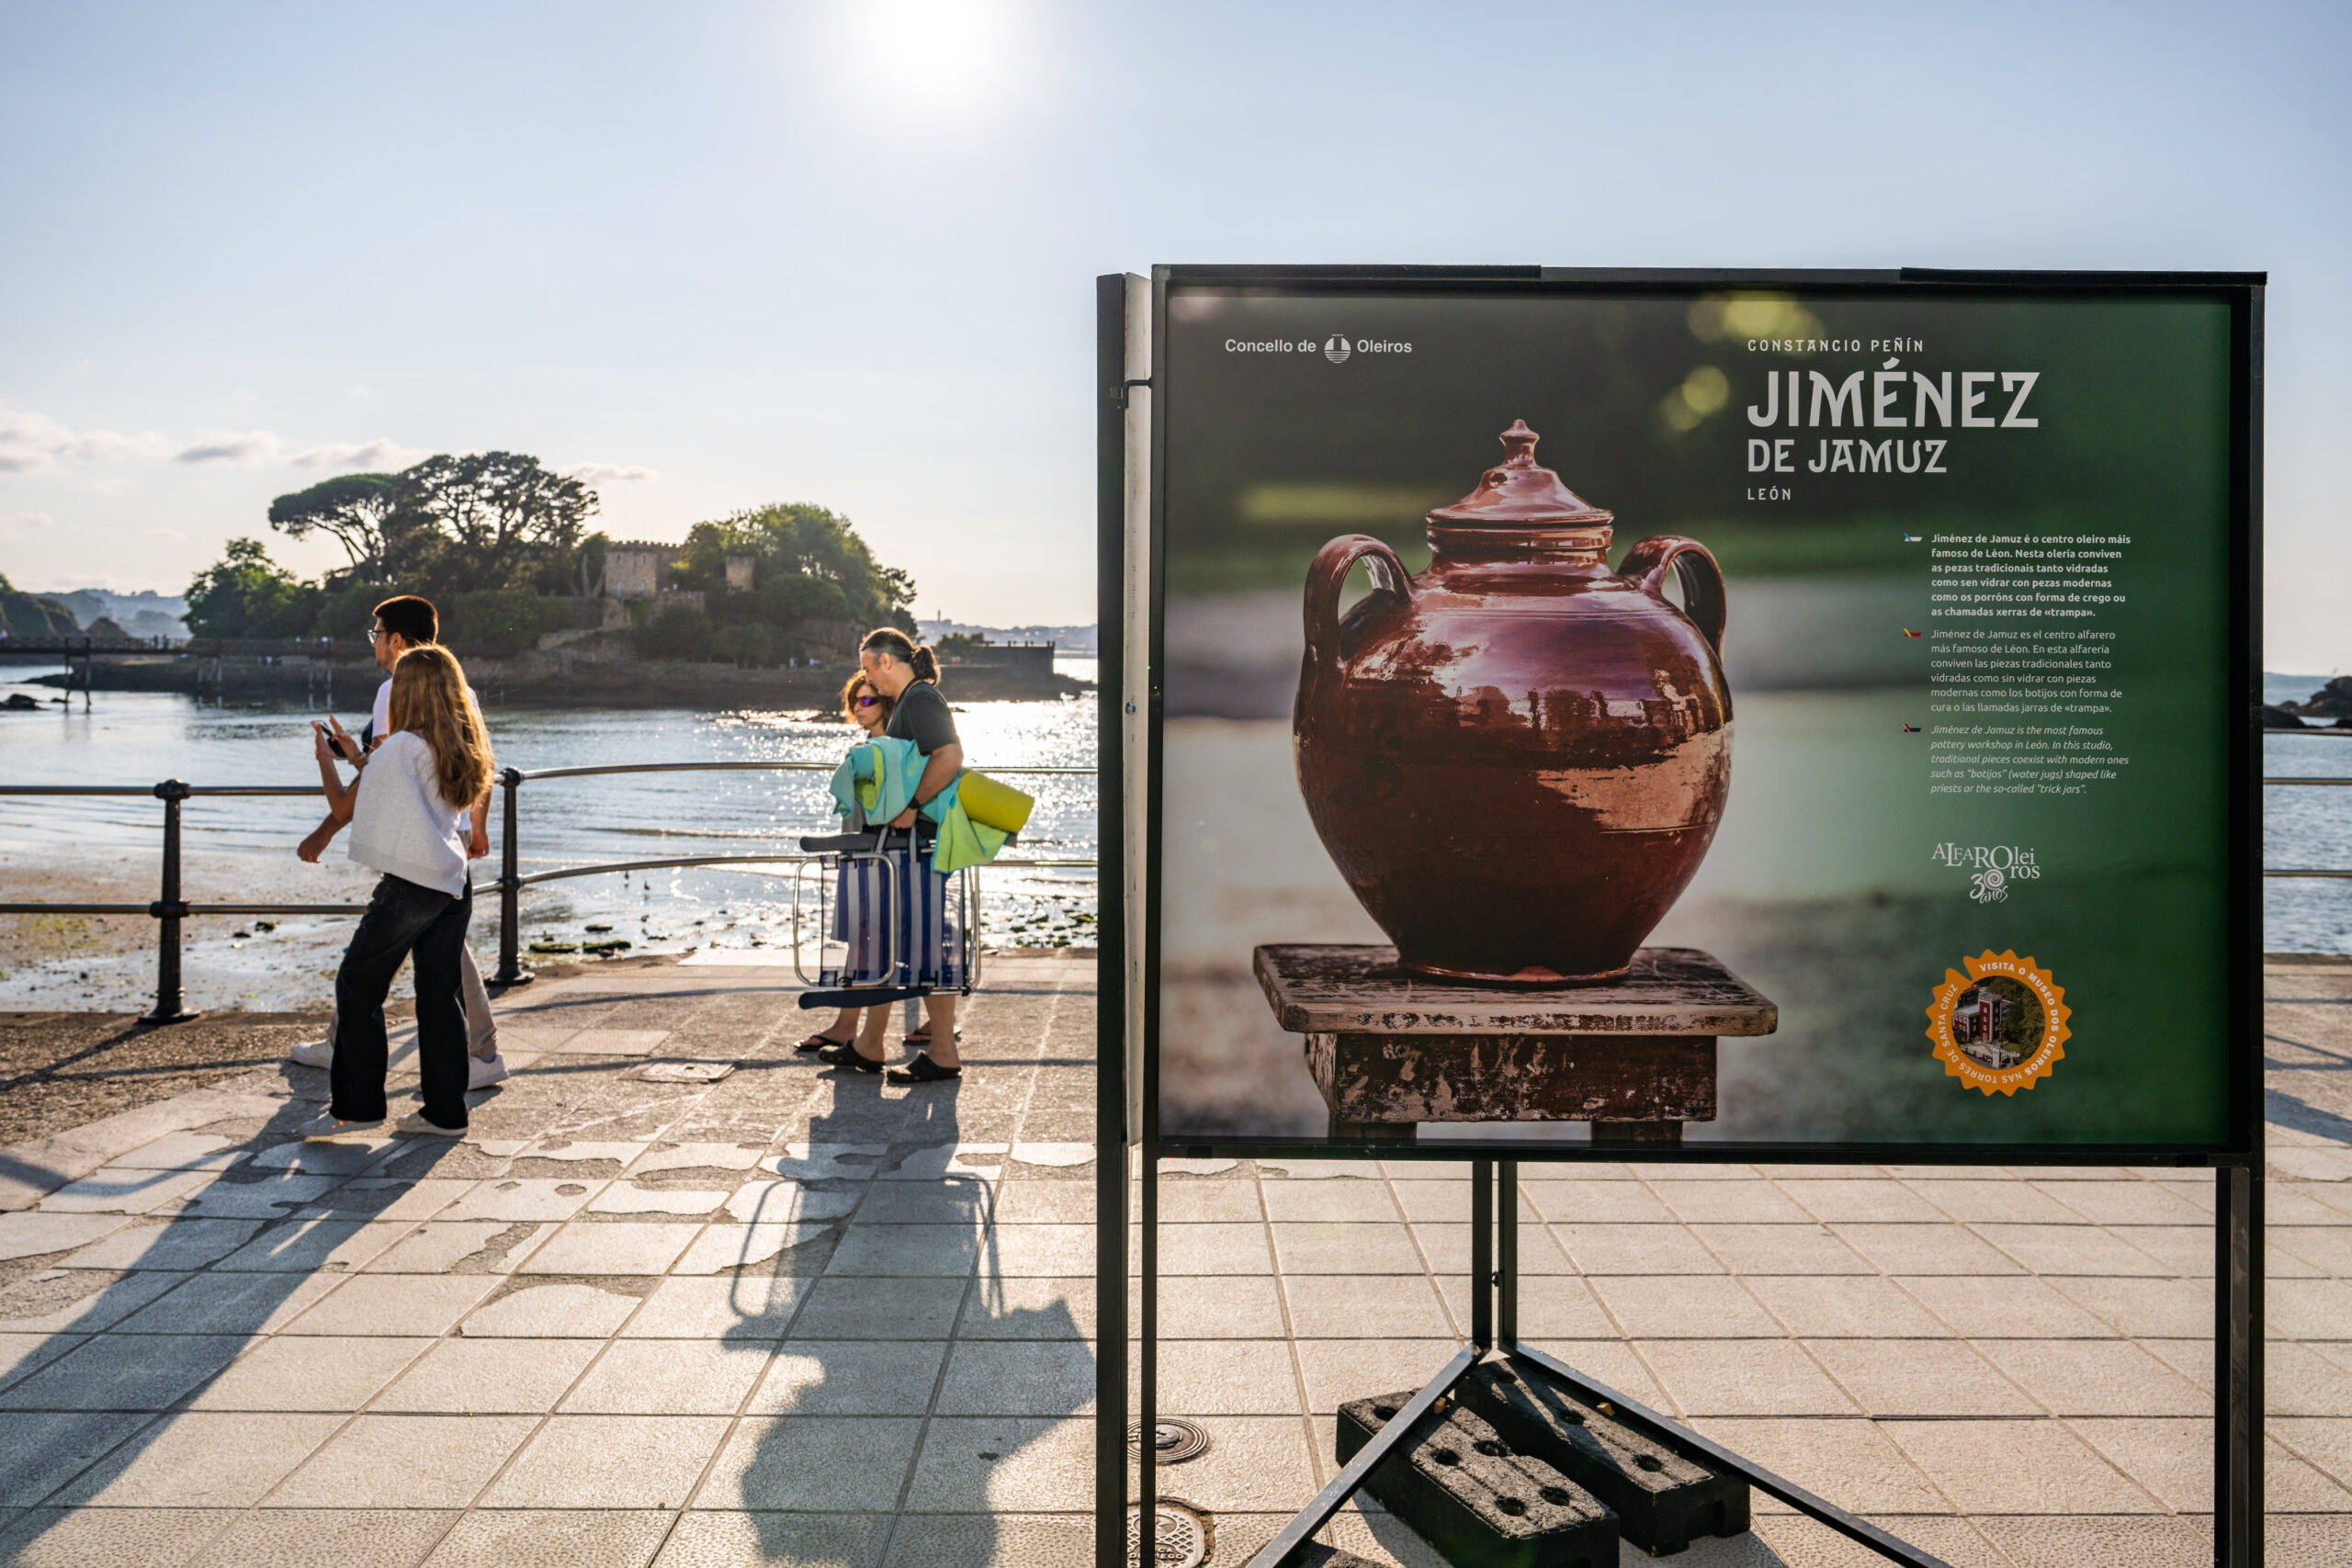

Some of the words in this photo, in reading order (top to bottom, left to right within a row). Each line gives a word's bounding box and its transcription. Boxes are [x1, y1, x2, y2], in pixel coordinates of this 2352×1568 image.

[1226, 339, 1293, 352] Concello
[1298, 340, 1316, 352] de
[1357, 340, 1412, 353] Oleiros
[1748, 340, 1860, 352] CONSTANCIO
[1871, 337, 1922, 352] PEÑÍN
[1747, 357, 2040, 427] JIMÉNEZ
[1748, 439, 1794, 472] DE
[1808, 439, 1948, 473] JAMUZ
[1747, 486, 1791, 500] LEÓN
[1931, 534, 1973, 543] Jiménez
[1975, 534, 1987, 543] de
[1990, 535, 2021, 543] Jamuz
[2024, 534, 2030, 543] é
[2041, 535, 2074, 543] centro
[2076, 534, 2106, 544] oleiro
[2109, 535, 2131, 544] máis
[1932, 548, 1968, 558] famoso
[1971, 548, 1983, 558] de
[1986, 548, 2012, 558] Léon.
[2016, 549, 2044, 558] Nesta
[2047, 549, 2075, 558] olería
[2078, 549, 2121, 558] conviven
[1945, 565, 1973, 573] pezas
[1975, 563, 2034, 572] tradicionais
[2037, 564, 2064, 572] tanto
[2066, 564, 2108, 572] vidradas
[1980, 578, 2009, 587] vidrar
[2032, 581, 2060, 589] pezas
[2063, 579, 2112, 587] modernas
[1974, 592, 2013, 603] porróns
[2036, 592, 2065, 602] forma
[2068, 592, 2080, 602] de
[2083, 595, 2110, 604] crego
[1945, 607, 1994, 615] chamadas
[2030, 607, 2042, 616] de
[1931, 629, 1971, 638] Jiménez
[1973, 629, 1984, 638] de
[1987, 630, 2018, 638] Jamuz
[2033, 629, 2041, 638] el
[2044, 630, 2075, 638] centro
[2077, 630, 2115, 639] alfarero
[1931, 644, 1951, 652] más
[1953, 644, 1988, 653] famoso
[1990, 644, 2002, 653] de
[2005, 644, 2030, 653] Léon.
[2033, 645, 2044, 653] En
[2047, 645, 2067, 653] esta
[2070, 645, 2109, 653] alfarería
[1931, 659, 1973, 668] conviven
[1975, 659, 1988, 668] las
[1991, 660, 2019, 669] piezas
[2022, 660, 2083, 668] tradicionales
[2086, 660, 2111, 669] tanto
[1931, 673, 1971, 682] vidradas
[2002, 674, 2014, 682] sin
[2018, 673, 2044, 682] vidrar
[2066, 674, 2096, 684] piezas
[1931, 688, 1978, 696] modernas
[2009, 688, 2022, 697] los
[2026, 688, 2057, 699] botijos
[2080, 688, 2108, 697] forma
[2110, 689, 2122, 697] de
[1962, 703, 1975, 711] las
[1978, 703, 2019, 712] llamadas
[2021, 704, 2048, 714] jarras
[2051, 703, 2063, 712] de
[1931, 726, 1969, 734] Jiménez
[1972, 726, 1983, 734] de
[1984, 726, 2015, 734] Jamuz
[2018, 726, 2024, 734] is
[2027, 726, 2042, 734] the
[2044, 726, 2067, 734] most
[2068, 726, 2103, 736] famous
[1931, 741, 1965, 750] pottery
[1968, 740, 2012, 750] workshop
[2015, 740, 2023, 749] in
[2026, 740, 2049, 749] León.
[2052, 740, 2061, 749] In
[2064, 740, 2080, 750] this
[2082, 740, 2112, 750] studio,
[1931, 755, 1980, 763] traditional
[1982, 755, 2010, 764] pieces
[2013, 755, 2044, 763] coexist
[2047, 755, 2067, 763] with
[2070, 755, 2105, 763] modern
[1931, 769, 1951, 777] such
[2008, 770, 2040, 780] (water
[2040, 770, 2064, 780] jugs)
[2065, 770, 2098, 781] shaped
[2100, 770, 2117, 779] like
[1931, 784, 1962, 794] priests
[1976, 784, 1991, 793] the
[1994, 784, 2034, 793] so-called
[1979, 885, 2008, 904] anos
[1979, 962, 2015, 972] VISITA
[2018, 967, 2026, 976] O
[2028, 972, 2055, 1006] MUSEO
[1940, 984, 1959, 1010] CRUZ
[2051, 1009, 2059, 1032] DOS
[1938, 1013, 1951, 1047] SANTA
[1947, 1049, 1960, 1063] DE
[2025, 1035, 2057, 1076] OLEIROS
[1959, 1062, 1997, 1084] TORRES
[2001, 1072, 2022, 1083] NAS
